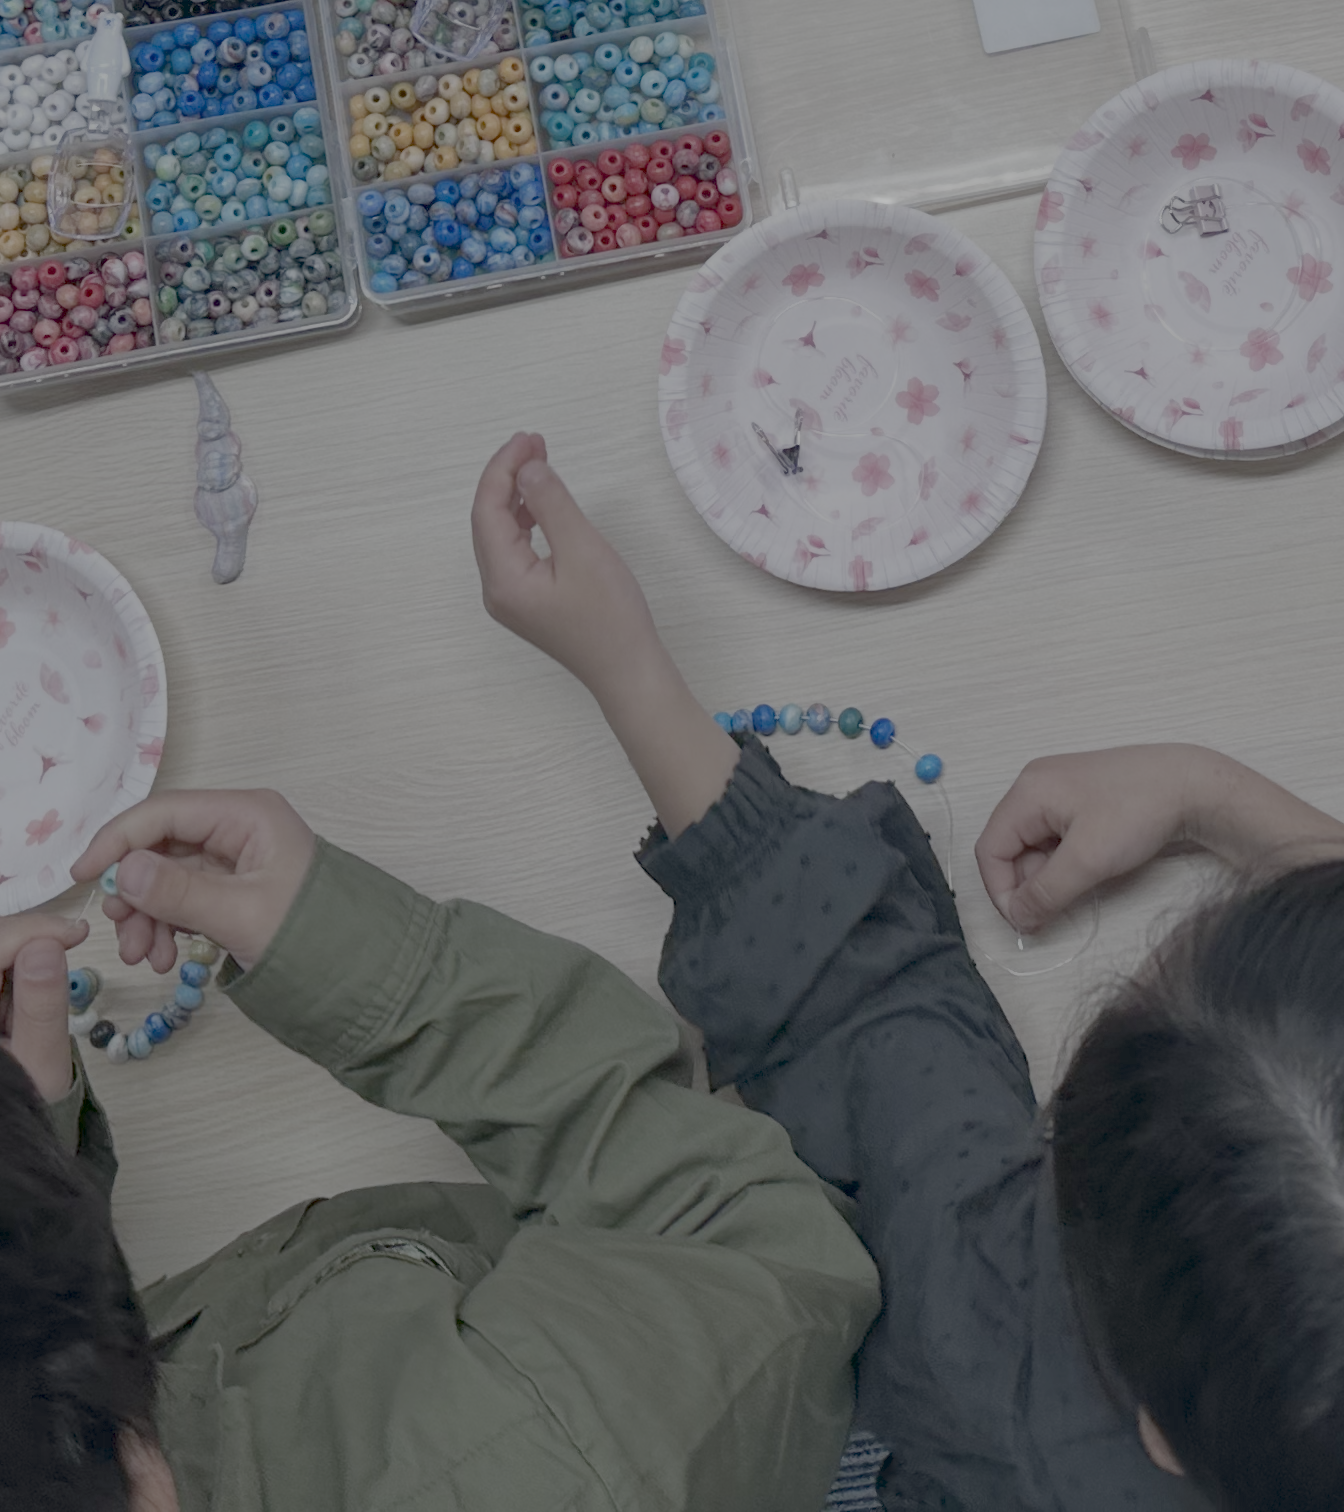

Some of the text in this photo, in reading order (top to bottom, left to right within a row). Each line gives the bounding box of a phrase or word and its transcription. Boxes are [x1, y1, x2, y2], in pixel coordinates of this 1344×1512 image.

[1209, 231, 1248, 274] bloom
[1222, 229, 1270, 296] favorite
[820, 357, 856, 400] bloom
[834, 354, 879, 422] favorite
[5, 703, 40, 747] bloom
